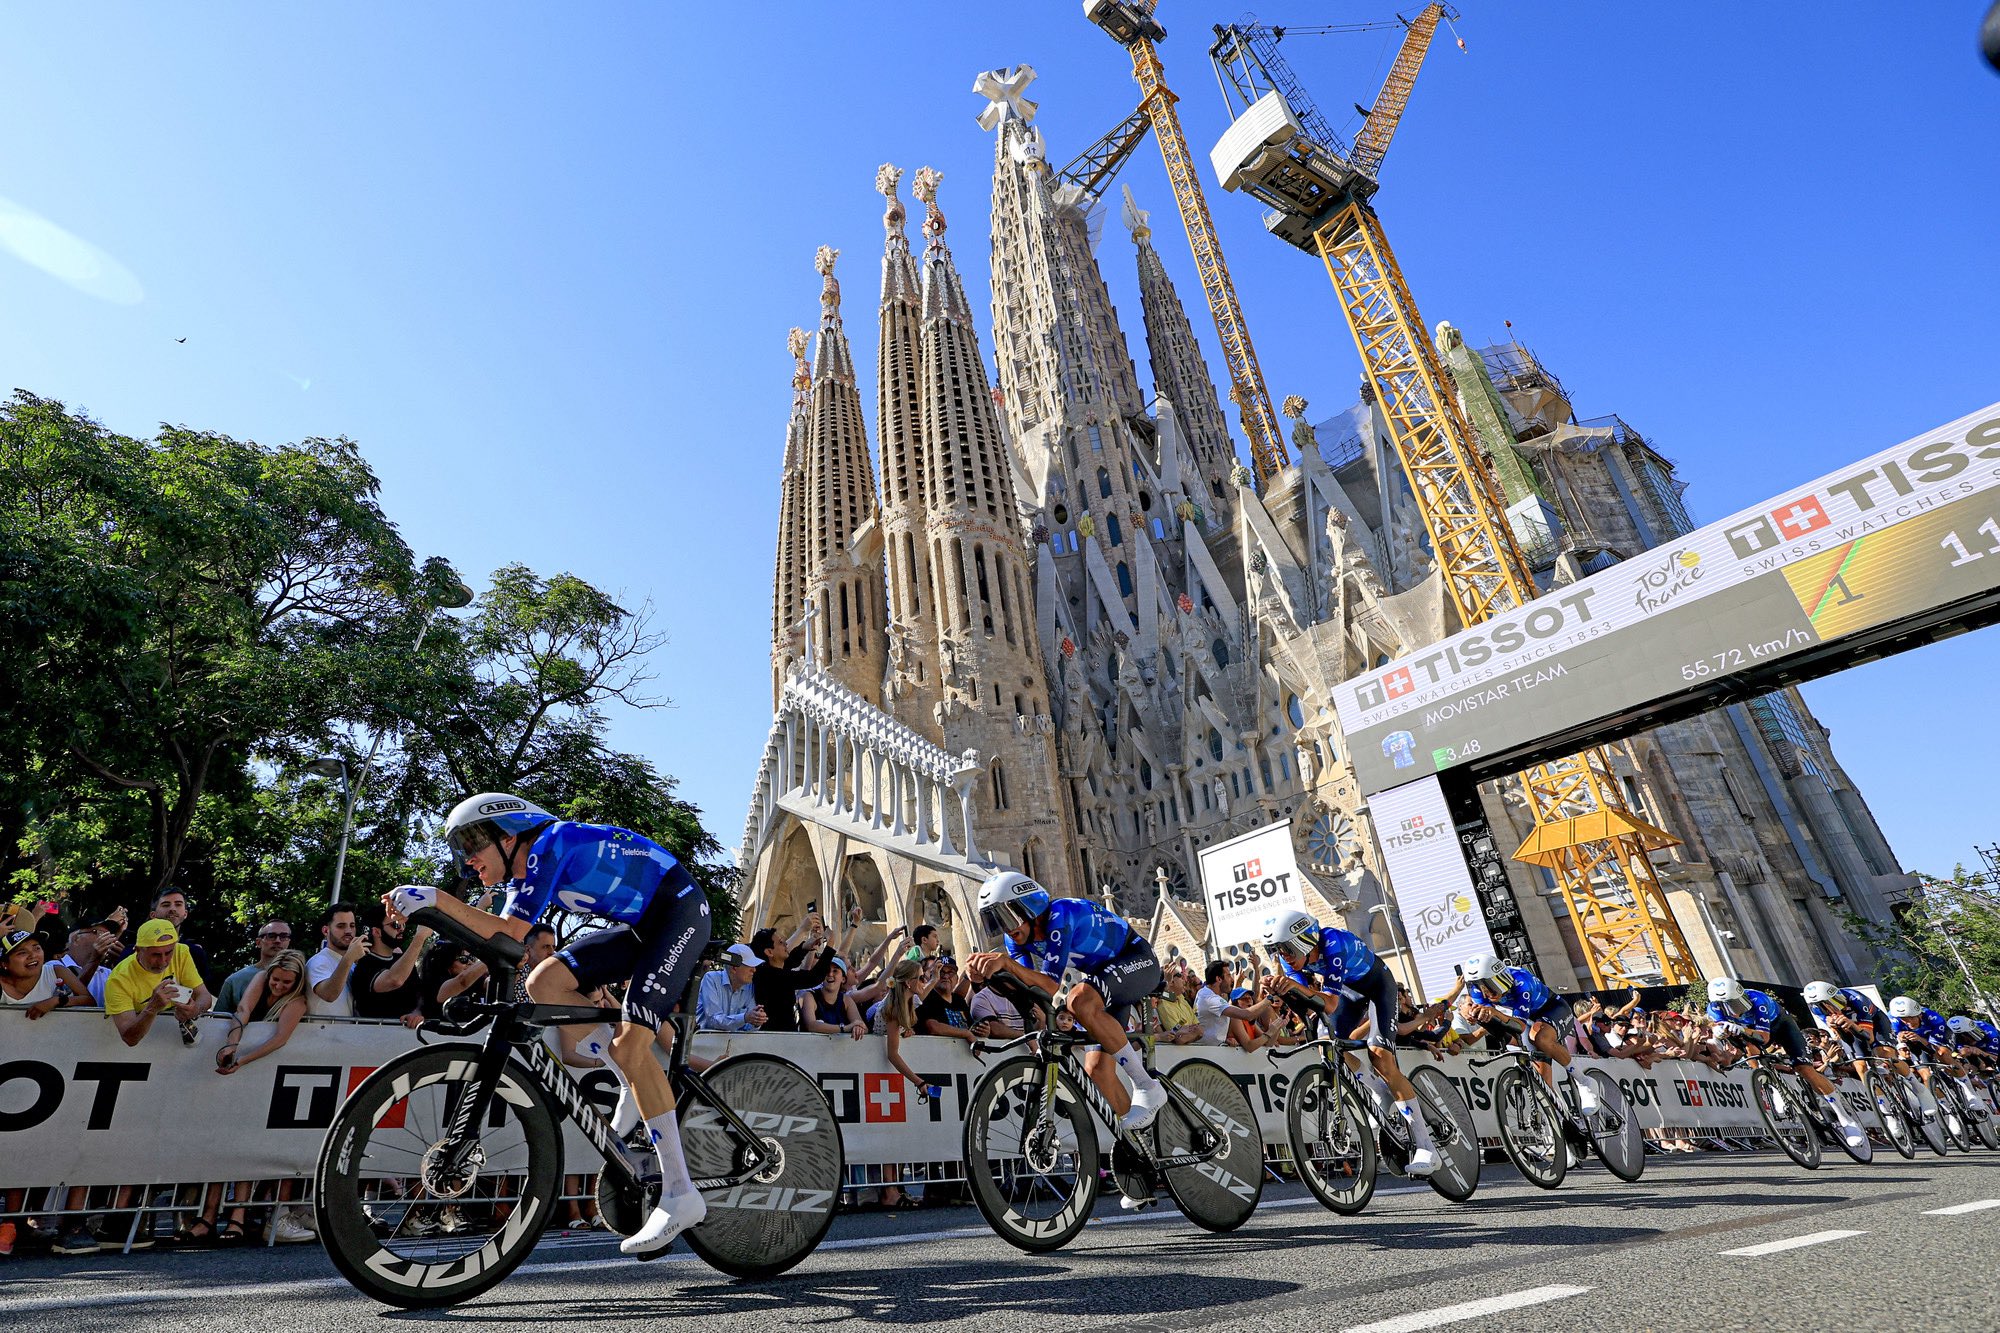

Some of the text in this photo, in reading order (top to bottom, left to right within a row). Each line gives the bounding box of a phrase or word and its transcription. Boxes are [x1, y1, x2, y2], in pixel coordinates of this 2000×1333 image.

[1311, 158, 1342, 183] LIEBHERR
[1743, 481, 1974, 577] SWISS WATCHES
[1828, 573, 1864, 606] 1
[1414, 587, 1595, 684] TISSOT
[1681, 628, 1811, 681] 55.72 km/h
[1363, 621, 1613, 726] SWISS WATCHES SINCE 1853
[1425, 663, 1568, 727] MOVISTAR TEAM
[486, 801, 522, 812] ABUS
[1386, 822, 1446, 848] TISSOT
[1016, 881, 1036, 894] ABUS
[1214, 872, 1290, 911] TISSOT
[1262, 899, 1280, 910] SINCE
[658, 926, 696, 977] Telefónica
[1118, 958, 1154, 975] Telefónica
[449, 1080, 482, 1146] CANYON
[531, 1042, 608, 1152] CANYON
[1698, 1080, 1749, 1108] TISSOT
